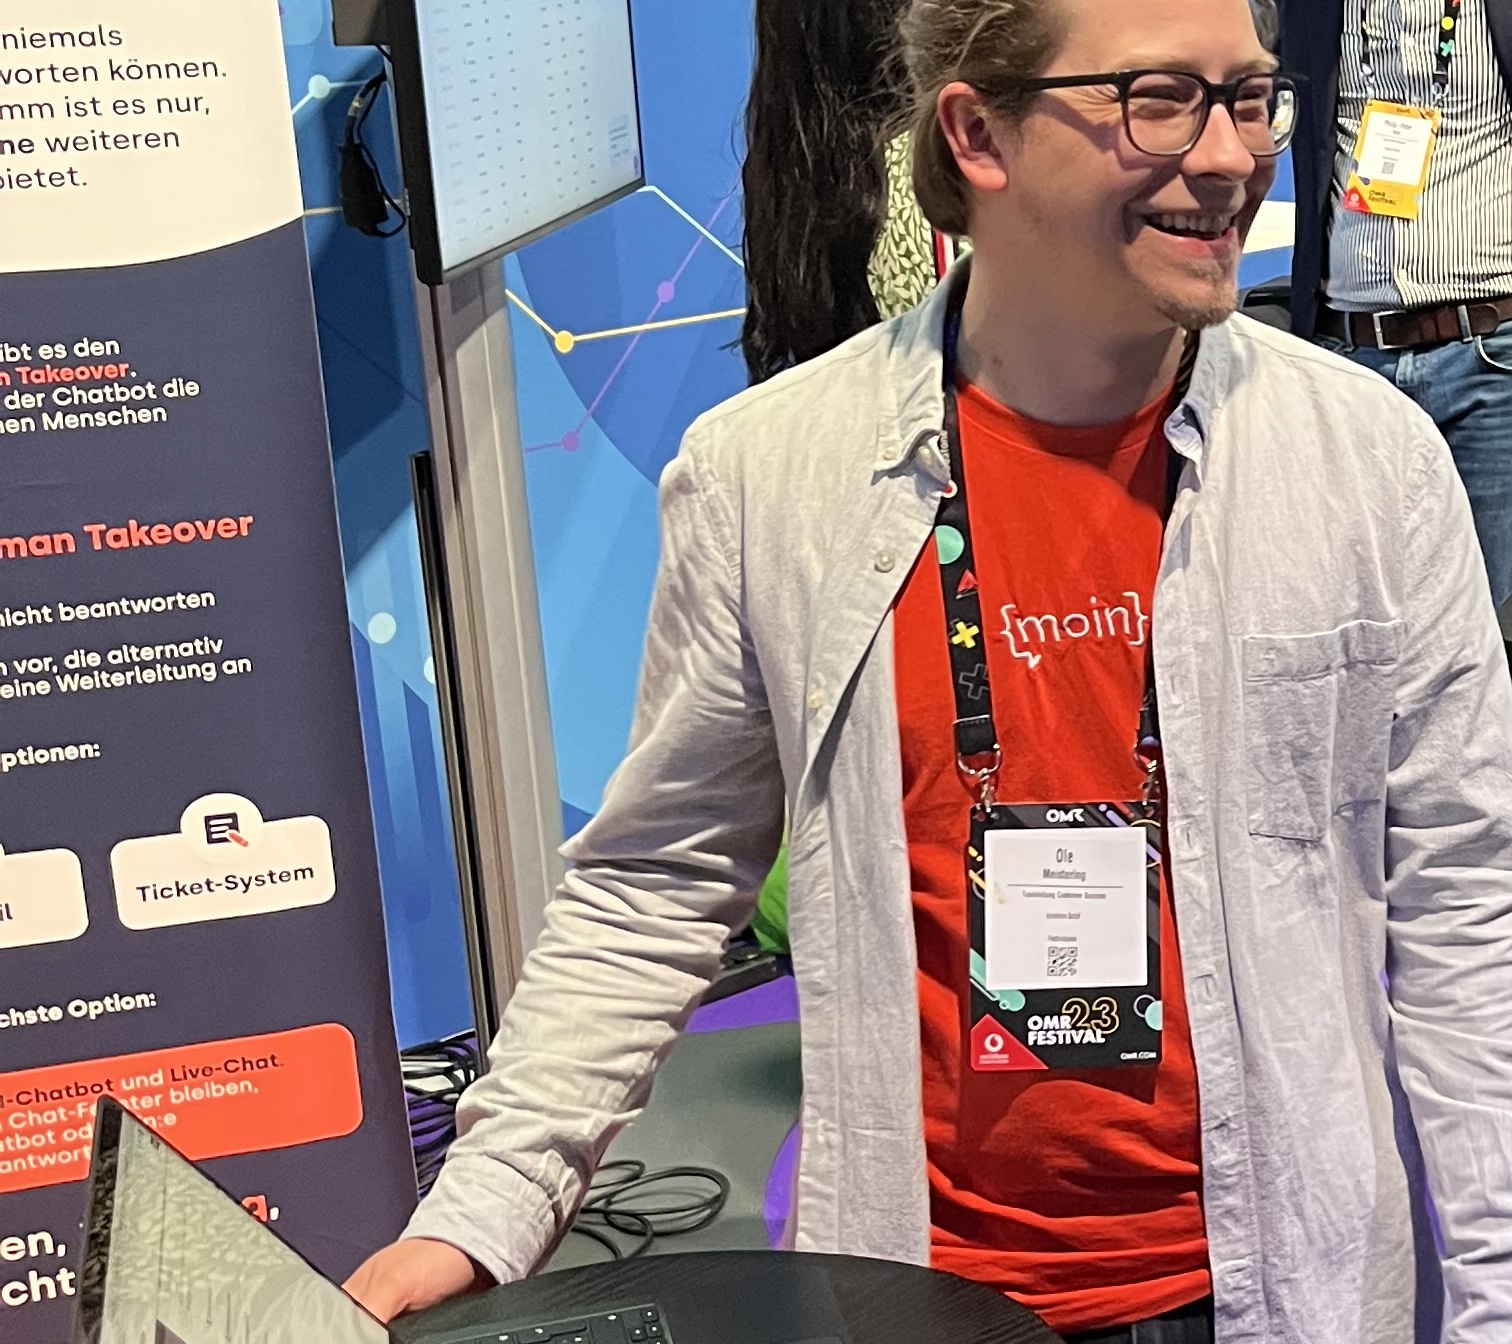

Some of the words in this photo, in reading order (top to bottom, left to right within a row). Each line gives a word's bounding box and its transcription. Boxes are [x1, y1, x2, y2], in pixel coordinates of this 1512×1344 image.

[2, 24, 123, 50] niemals
[108, 58, 228, 82] können.
[64, 95, 103, 118] ist
[112, 97, 146, 116] es
[156, 95, 211, 117] nur,
[45, 129, 180, 154] weiteren
[38, 343, 67, 360] es
[73, 338, 121, 358] den
[15, 361, 137, 385] Takeover.
[4, 390, 46, 410] der
[52, 380, 158, 406] Chatbot
[162, 377, 200, 399] die
[42, 405, 168, 432] Menschen
[84, 514, 255, 552] Takeover
[58, 590, 216, 623] beantworten
[14, 653, 58, 674] vor,
[64, 648, 101, 670] die
[107, 635, 224, 664] alternativ
[1, 679, 51, 699] eine
[55, 660, 217, 694] Weiterleitung
[222, 656, 252, 676] an
[1, 741, 101, 772] ptionen:
[1046, 808, 1085, 823] OMR
[135, 862, 315, 903] Ticket-System
[67, 990, 157, 1020] Option:
[1062, 996, 1120, 1035] 23
[1027, 1014, 1074, 1031] OMR
[1027, 1028, 1106, 1046] FESTIVAL
[121, 1068, 164, 1091] und
[169, 1077, 260, 1106] bleiben,
[0, 1229, 67, 1262] en,
[1, 1266, 77, 1307] cht
